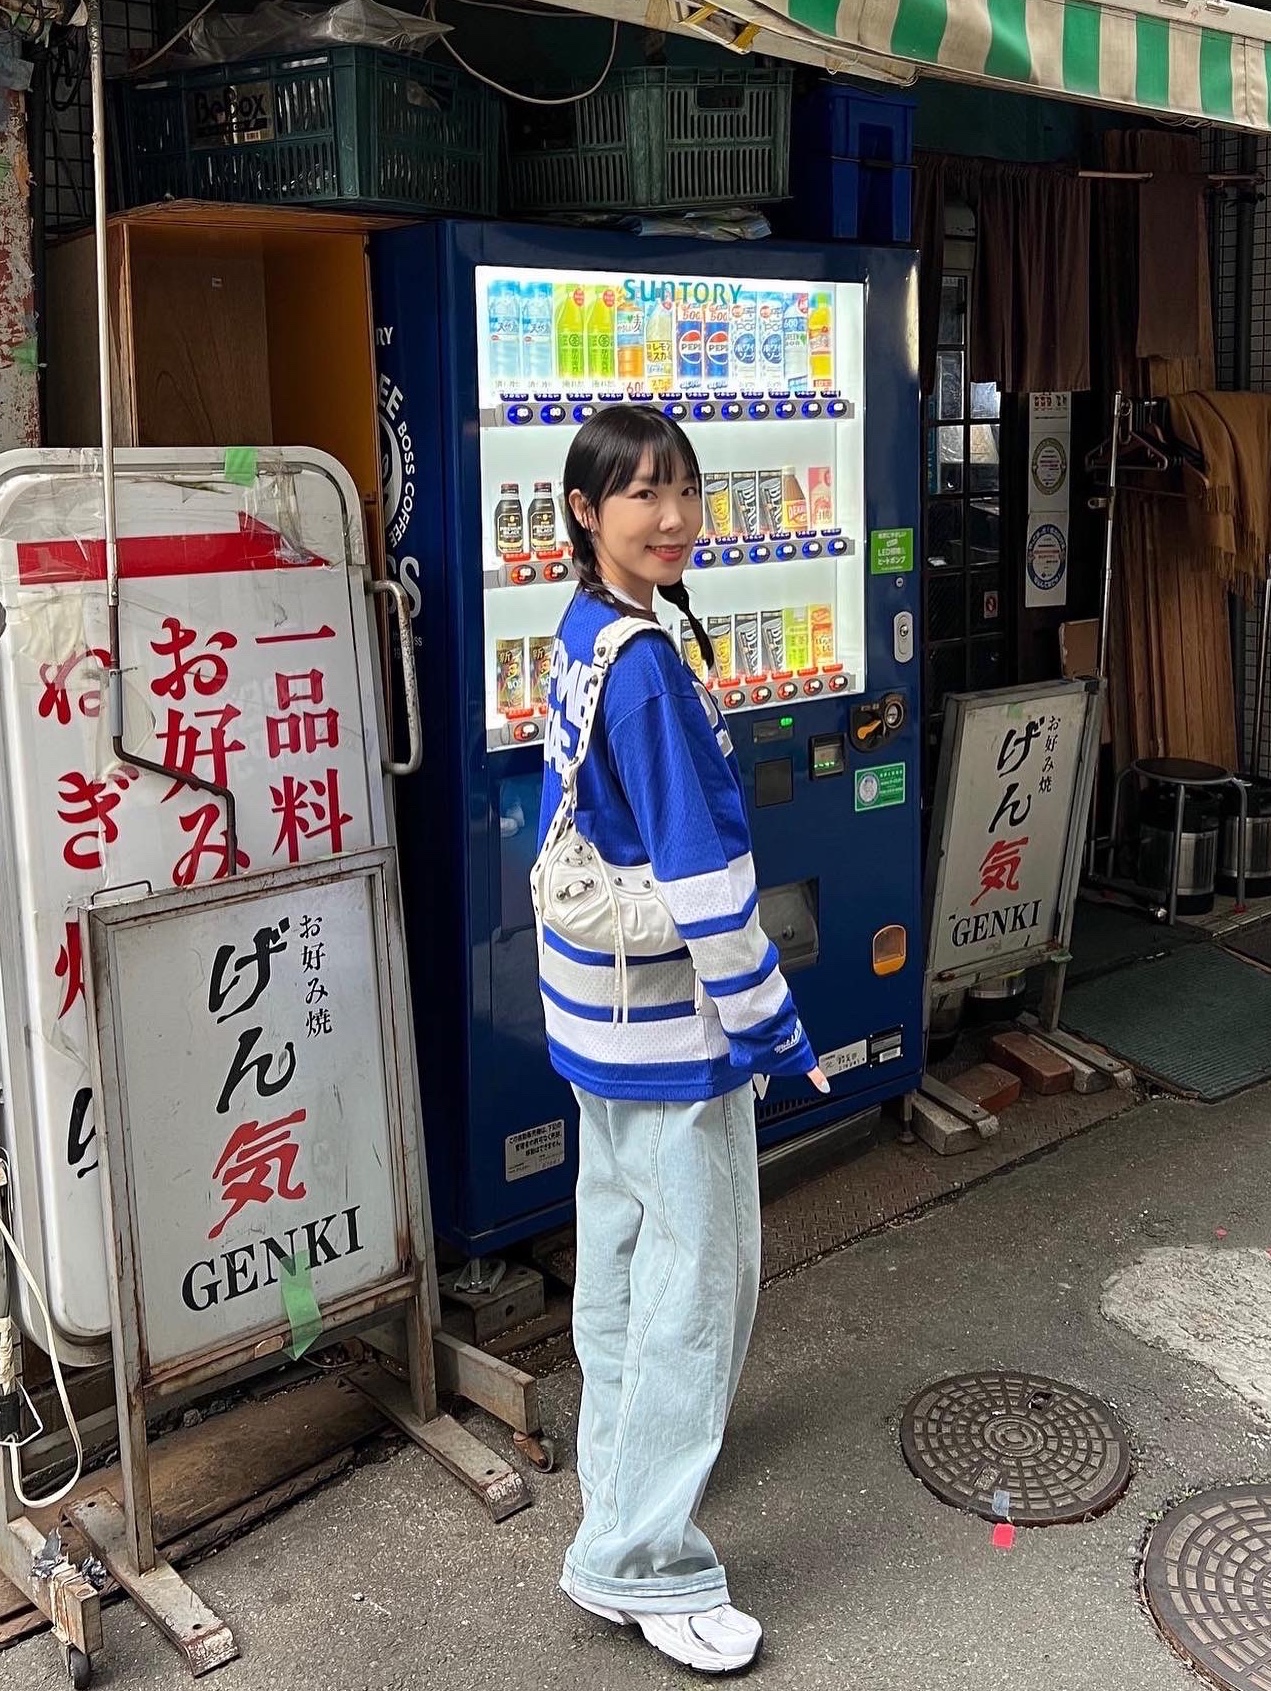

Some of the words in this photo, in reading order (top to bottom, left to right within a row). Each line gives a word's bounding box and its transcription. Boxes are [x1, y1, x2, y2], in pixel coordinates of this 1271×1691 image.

[397, 420, 415, 475] BOSS
[388, 482, 415, 548] COFFEE
[1039, 716, 1061, 793] お好み焼
[970, 716, 1045, 907] げん気
[952, 899, 1042, 947] GENKI
[299, 914, 333, 1039] お好み焼
[208, 917, 306, 1240] げん気
[181, 1205, 364, 1311] GENKI
